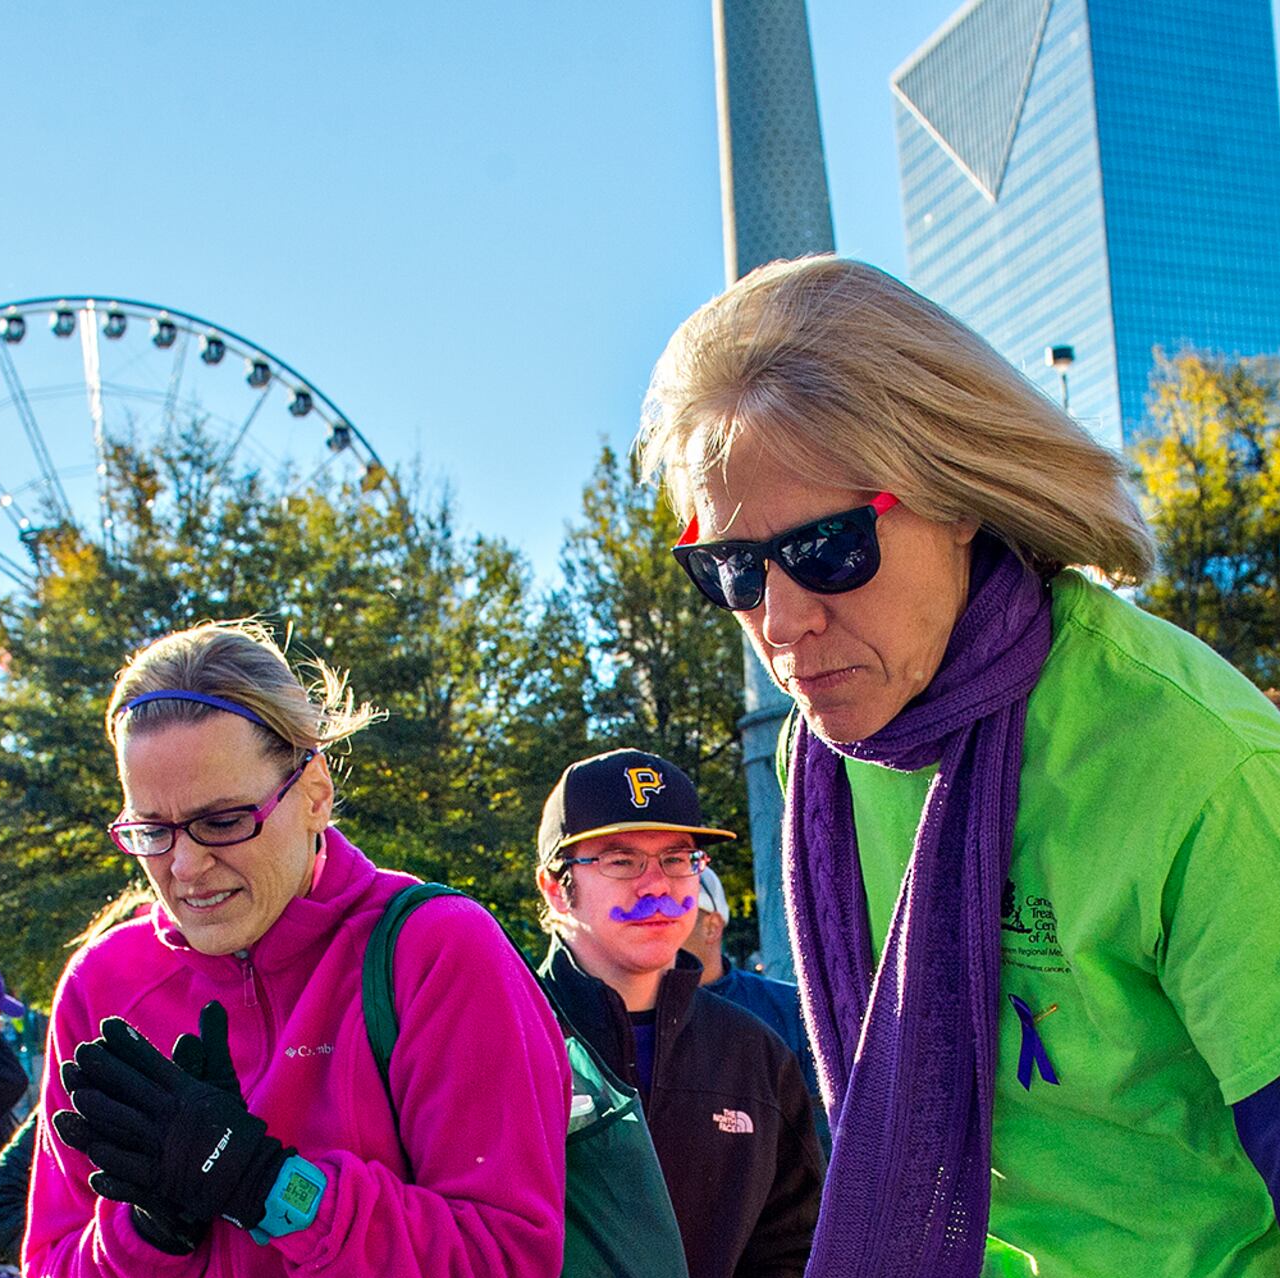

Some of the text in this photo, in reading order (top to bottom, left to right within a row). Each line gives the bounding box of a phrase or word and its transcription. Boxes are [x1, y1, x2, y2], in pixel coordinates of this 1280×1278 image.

[624, 767, 666, 808] P
[1028, 931, 1041, 943] of
[1034, 919, 1057, 931] Cen
[201, 1127, 233, 1173] HEAD
